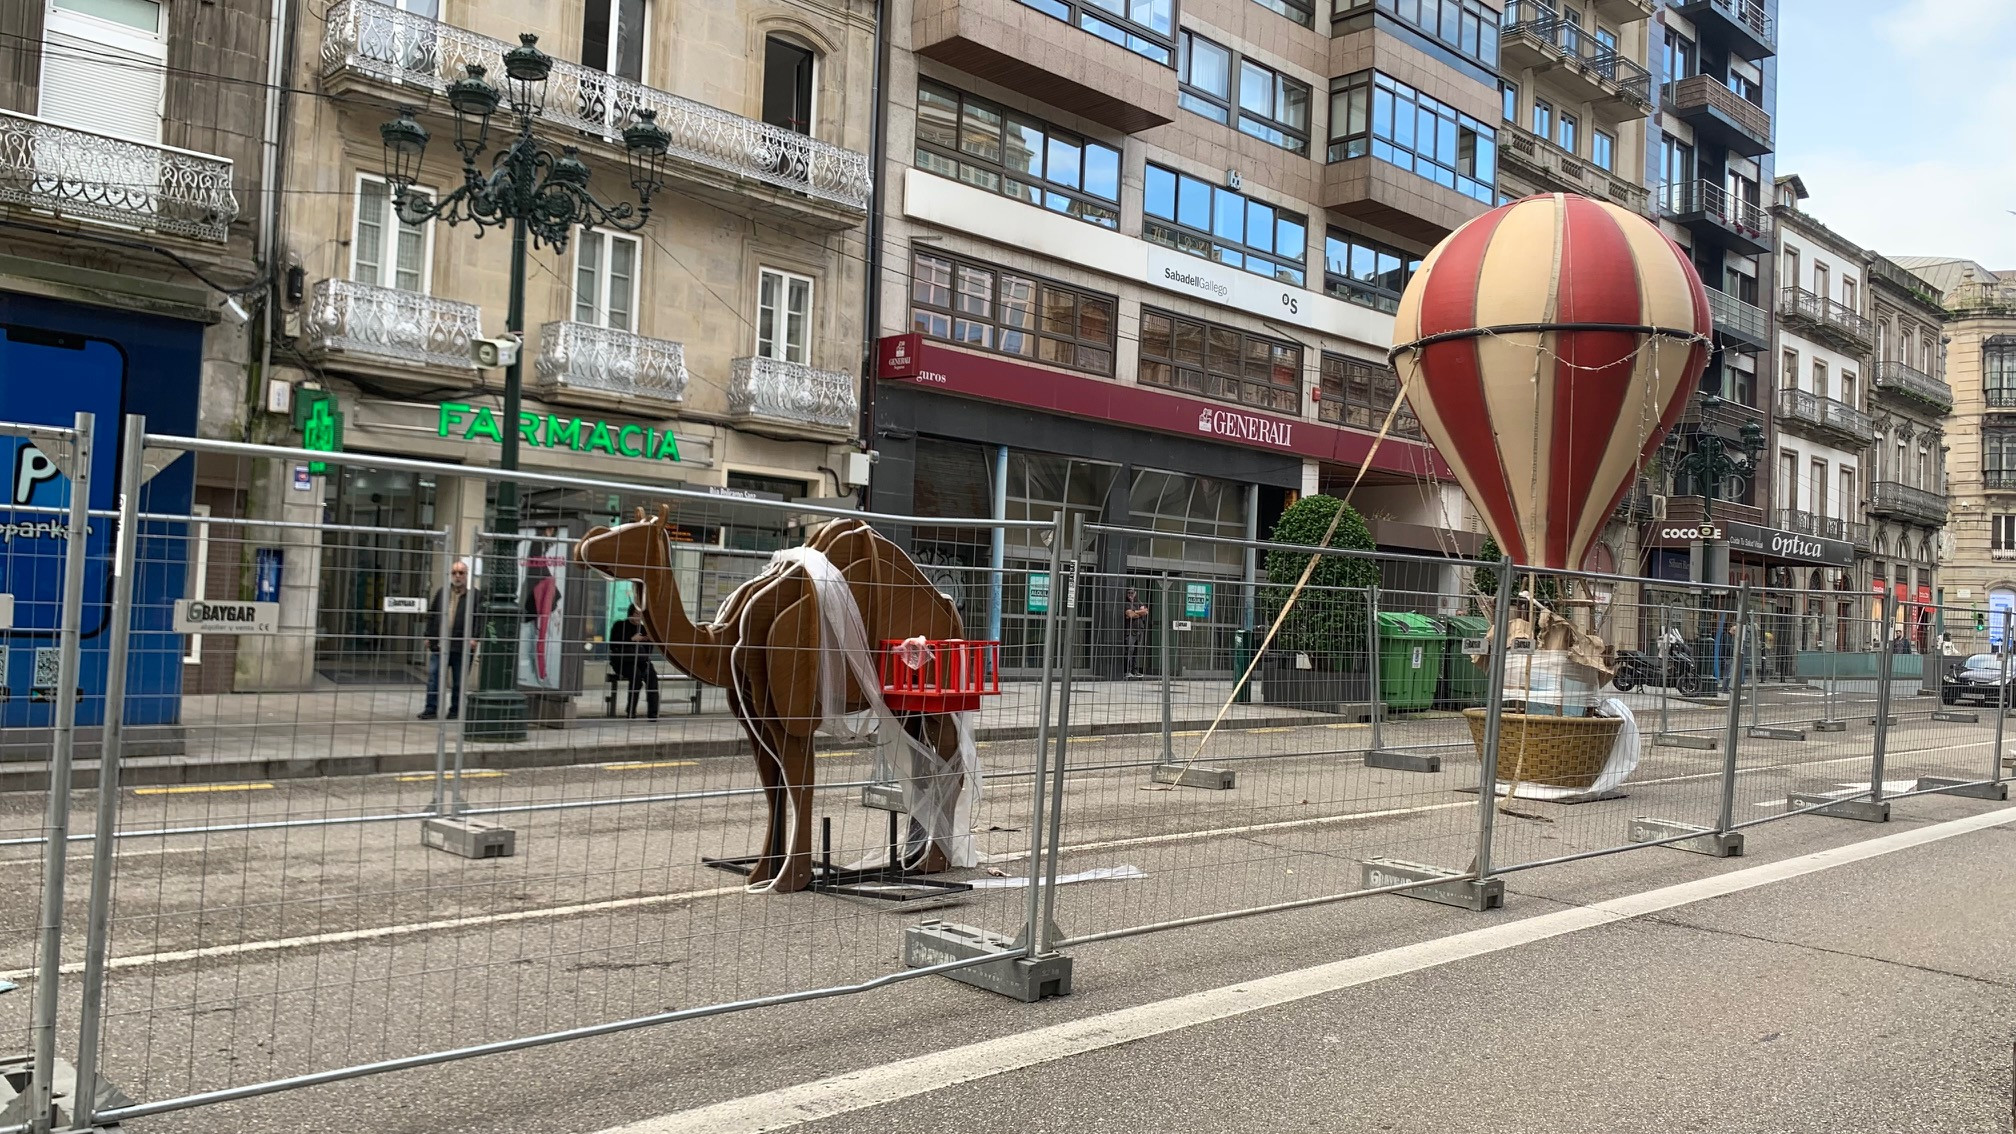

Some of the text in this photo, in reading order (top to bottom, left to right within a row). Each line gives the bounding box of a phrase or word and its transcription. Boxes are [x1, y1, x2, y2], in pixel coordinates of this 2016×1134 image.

[1164, 267, 1228, 297] SabadellGallego
[438, 401, 682, 463] FARMACIA
[1213, 410, 1293, 447] GENERALI
[1661, 528, 1721, 539] COCOE
[1771, 533, 1822, 557] óptica
[202, 604, 256, 622] BAYGAR
